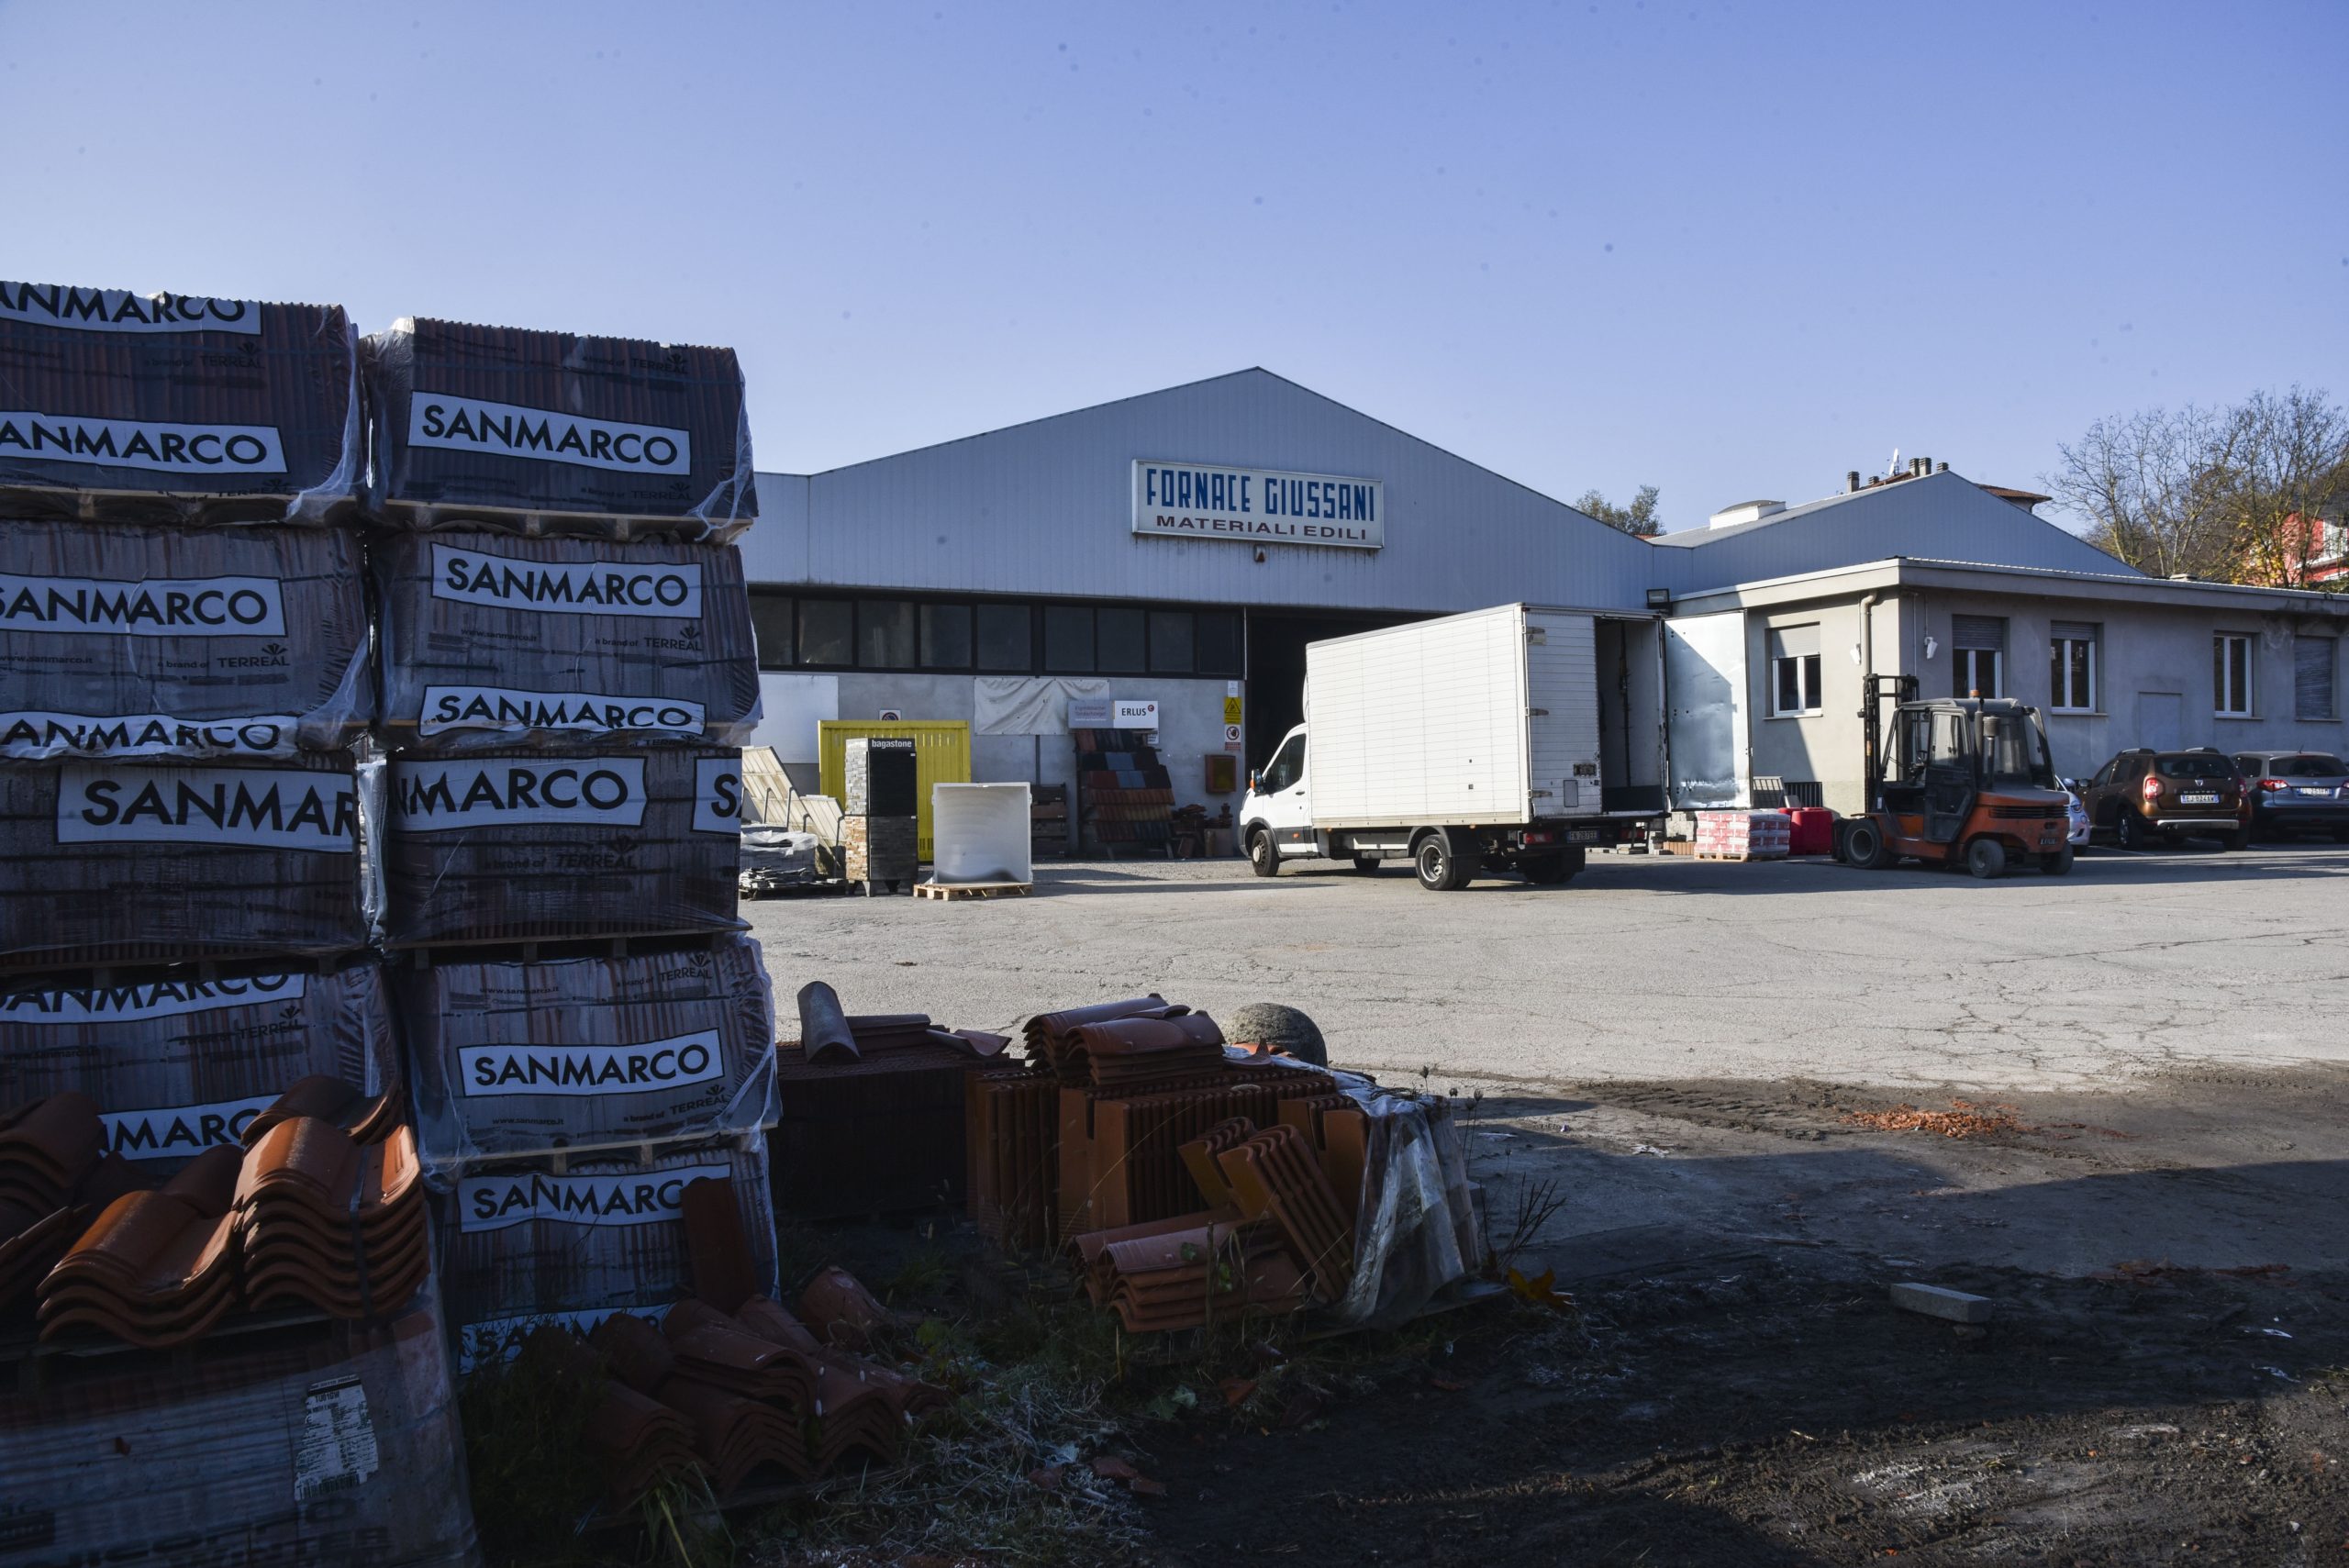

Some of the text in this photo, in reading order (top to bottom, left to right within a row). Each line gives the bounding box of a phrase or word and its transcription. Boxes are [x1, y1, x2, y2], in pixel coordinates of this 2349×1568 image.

[422, 404, 677, 465] SANMARCO
[631, 489, 694, 501] TERREAL
[1147, 469, 1375, 521] FORNACE GIUSSANI
[1157, 515, 1366, 540] MATERIALI EDILI
[446, 558, 688, 606] SANMARCO
[0, 586, 268, 626] ANMARCO
[644, 637, 705, 651] TERREAL
[217, 656, 290, 669] TERREAL
[435, 694, 692, 728] SANMARCO
[1121, 707, 1147, 717] ERLUS
[872, 740, 912, 749] bagastone
[556, 853, 636, 870] TERREAL
[660, 967, 713, 982] TERREAL
[474, 1044, 709, 1086] SANMARCO
[669, 1095, 728, 1115] TERREAL
[474, 1173, 711, 1219] SANMARC
